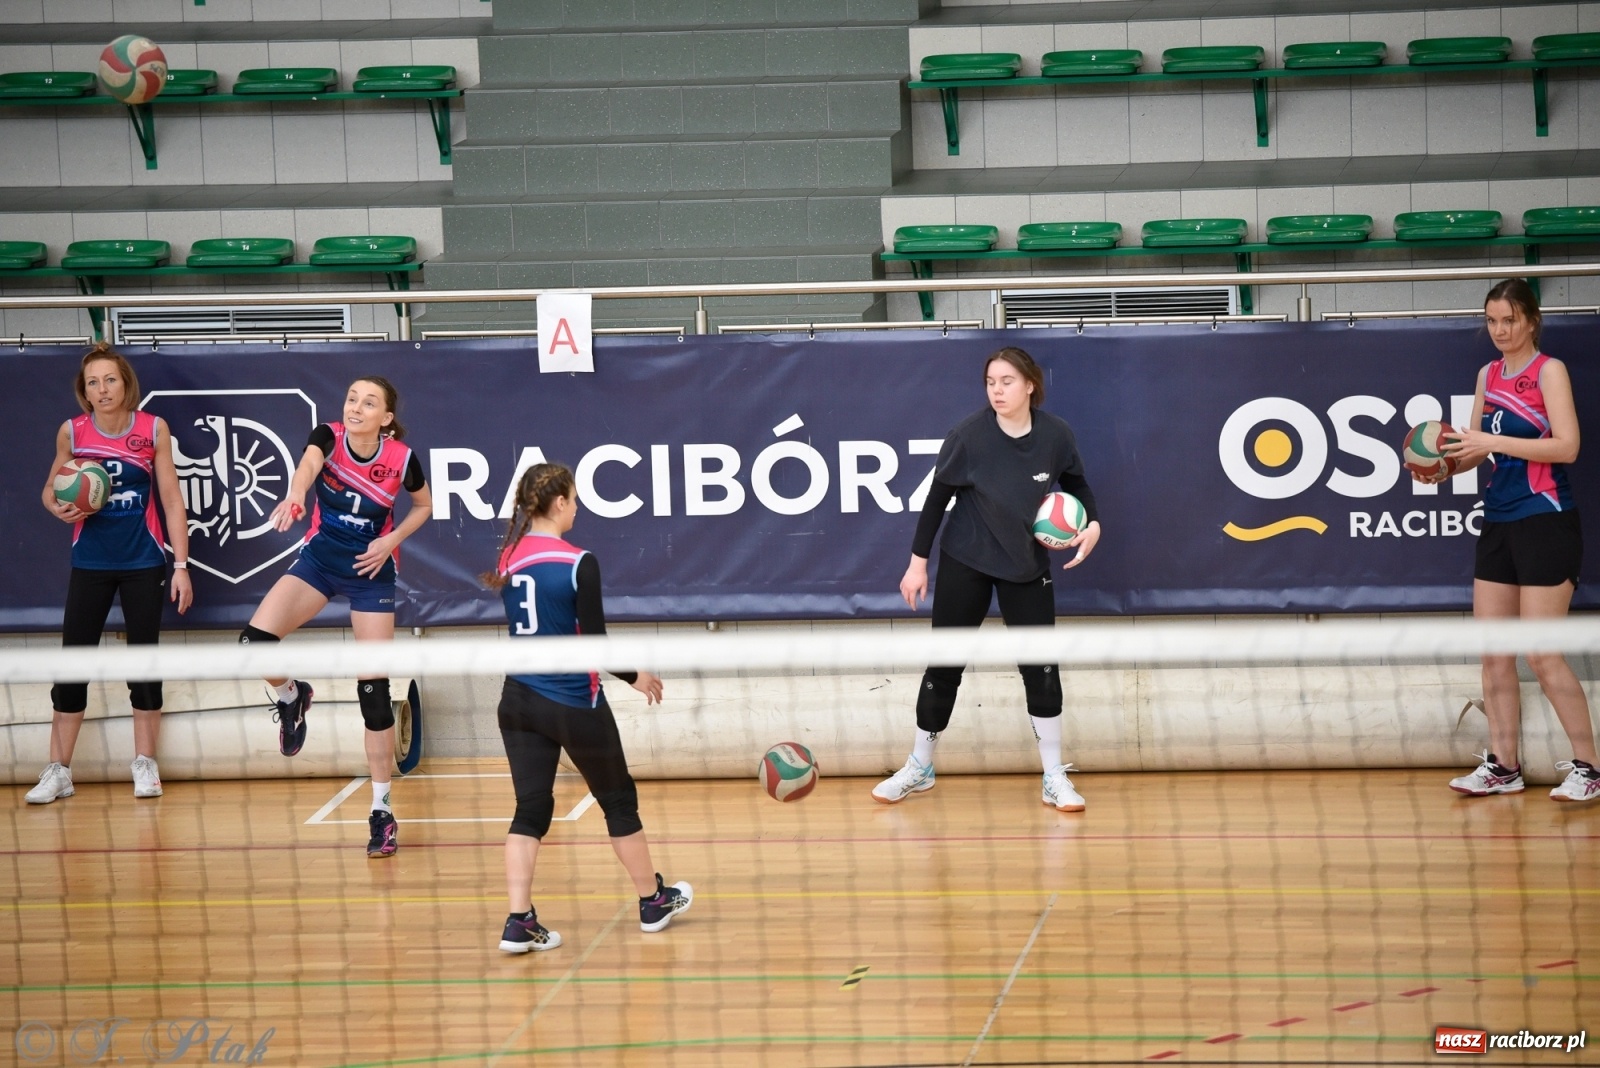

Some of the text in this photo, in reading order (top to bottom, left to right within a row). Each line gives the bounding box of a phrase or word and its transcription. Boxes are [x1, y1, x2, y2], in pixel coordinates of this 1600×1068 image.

[549, 318, 579, 354] A
[1491, 410, 1504, 435] 8
[106, 461, 123, 487] 2
[345, 491, 362, 514] 7
[511, 574, 539, 635] 3
